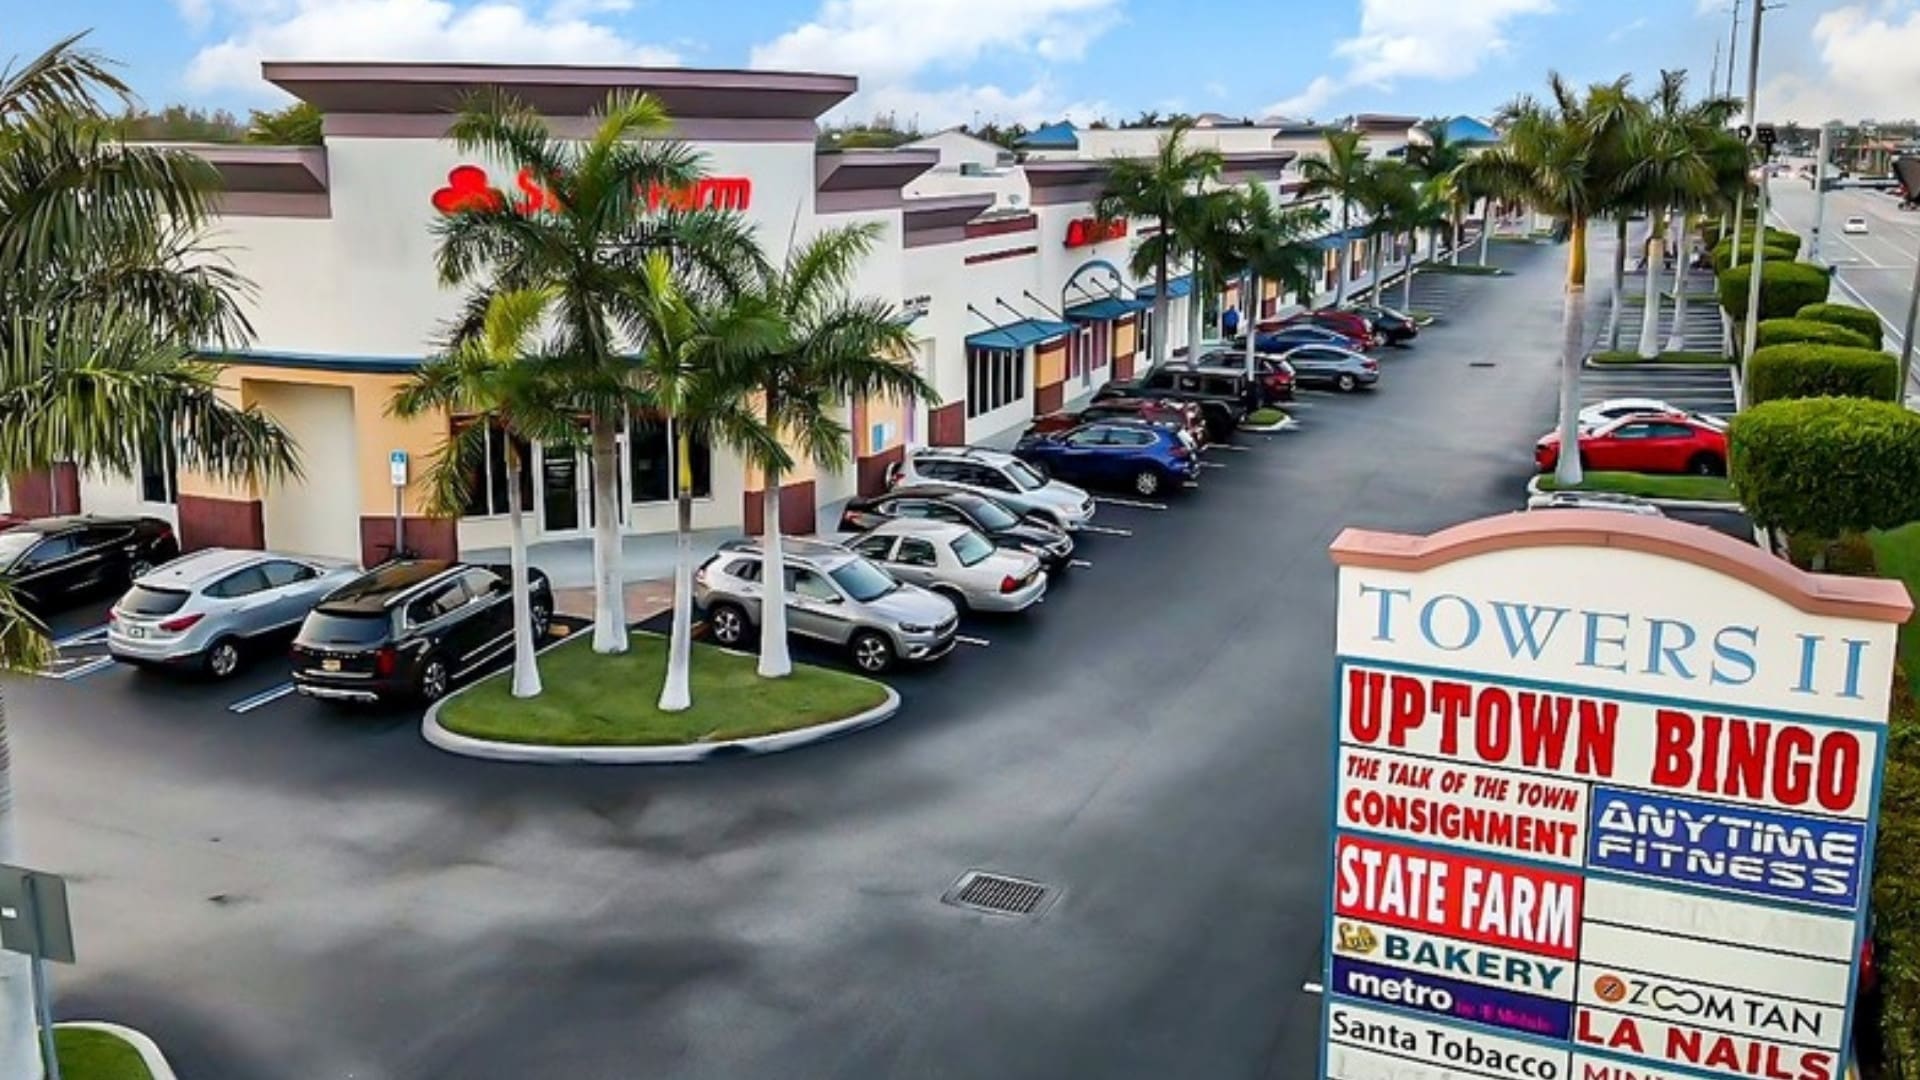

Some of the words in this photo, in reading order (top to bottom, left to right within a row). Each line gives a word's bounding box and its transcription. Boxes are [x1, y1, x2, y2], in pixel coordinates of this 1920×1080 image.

[1359, 584, 1760, 685] TOWERS
[1789, 632, 1871, 700] II
[1348, 669, 1620, 777] UPTOWN
[1651, 709, 1861, 812] BINGO
[1346, 755, 1381, 781] THE
[1387, 763, 1434, 790] TALK
[1440, 770, 1467, 794] OF
[1473, 775, 1510, 801] THE
[1517, 782, 1579, 813] TOWN
[1344, 788, 1578, 858] CONSIGNMENT
[1598, 800, 1858, 866] ANYTIME
[1339, 844, 1449, 925] STATE
[1460, 866, 1575, 949] FARM
[1598, 834, 1850, 896] FITNESS
[1348, 971, 1454, 1010] metro
[1385, 934, 1564, 990] BAKERY
[1628, 980, 1735, 1023] ZOOM
[1743, 1000, 1822, 1037] TAN
[1332, 1010, 1417, 1051] Santa
[1426, 1030, 1558, 1080] Tobacco
[1577, 1010, 1645, 1053] LA
[1666, 1026, 1832, 1080] NAILS
